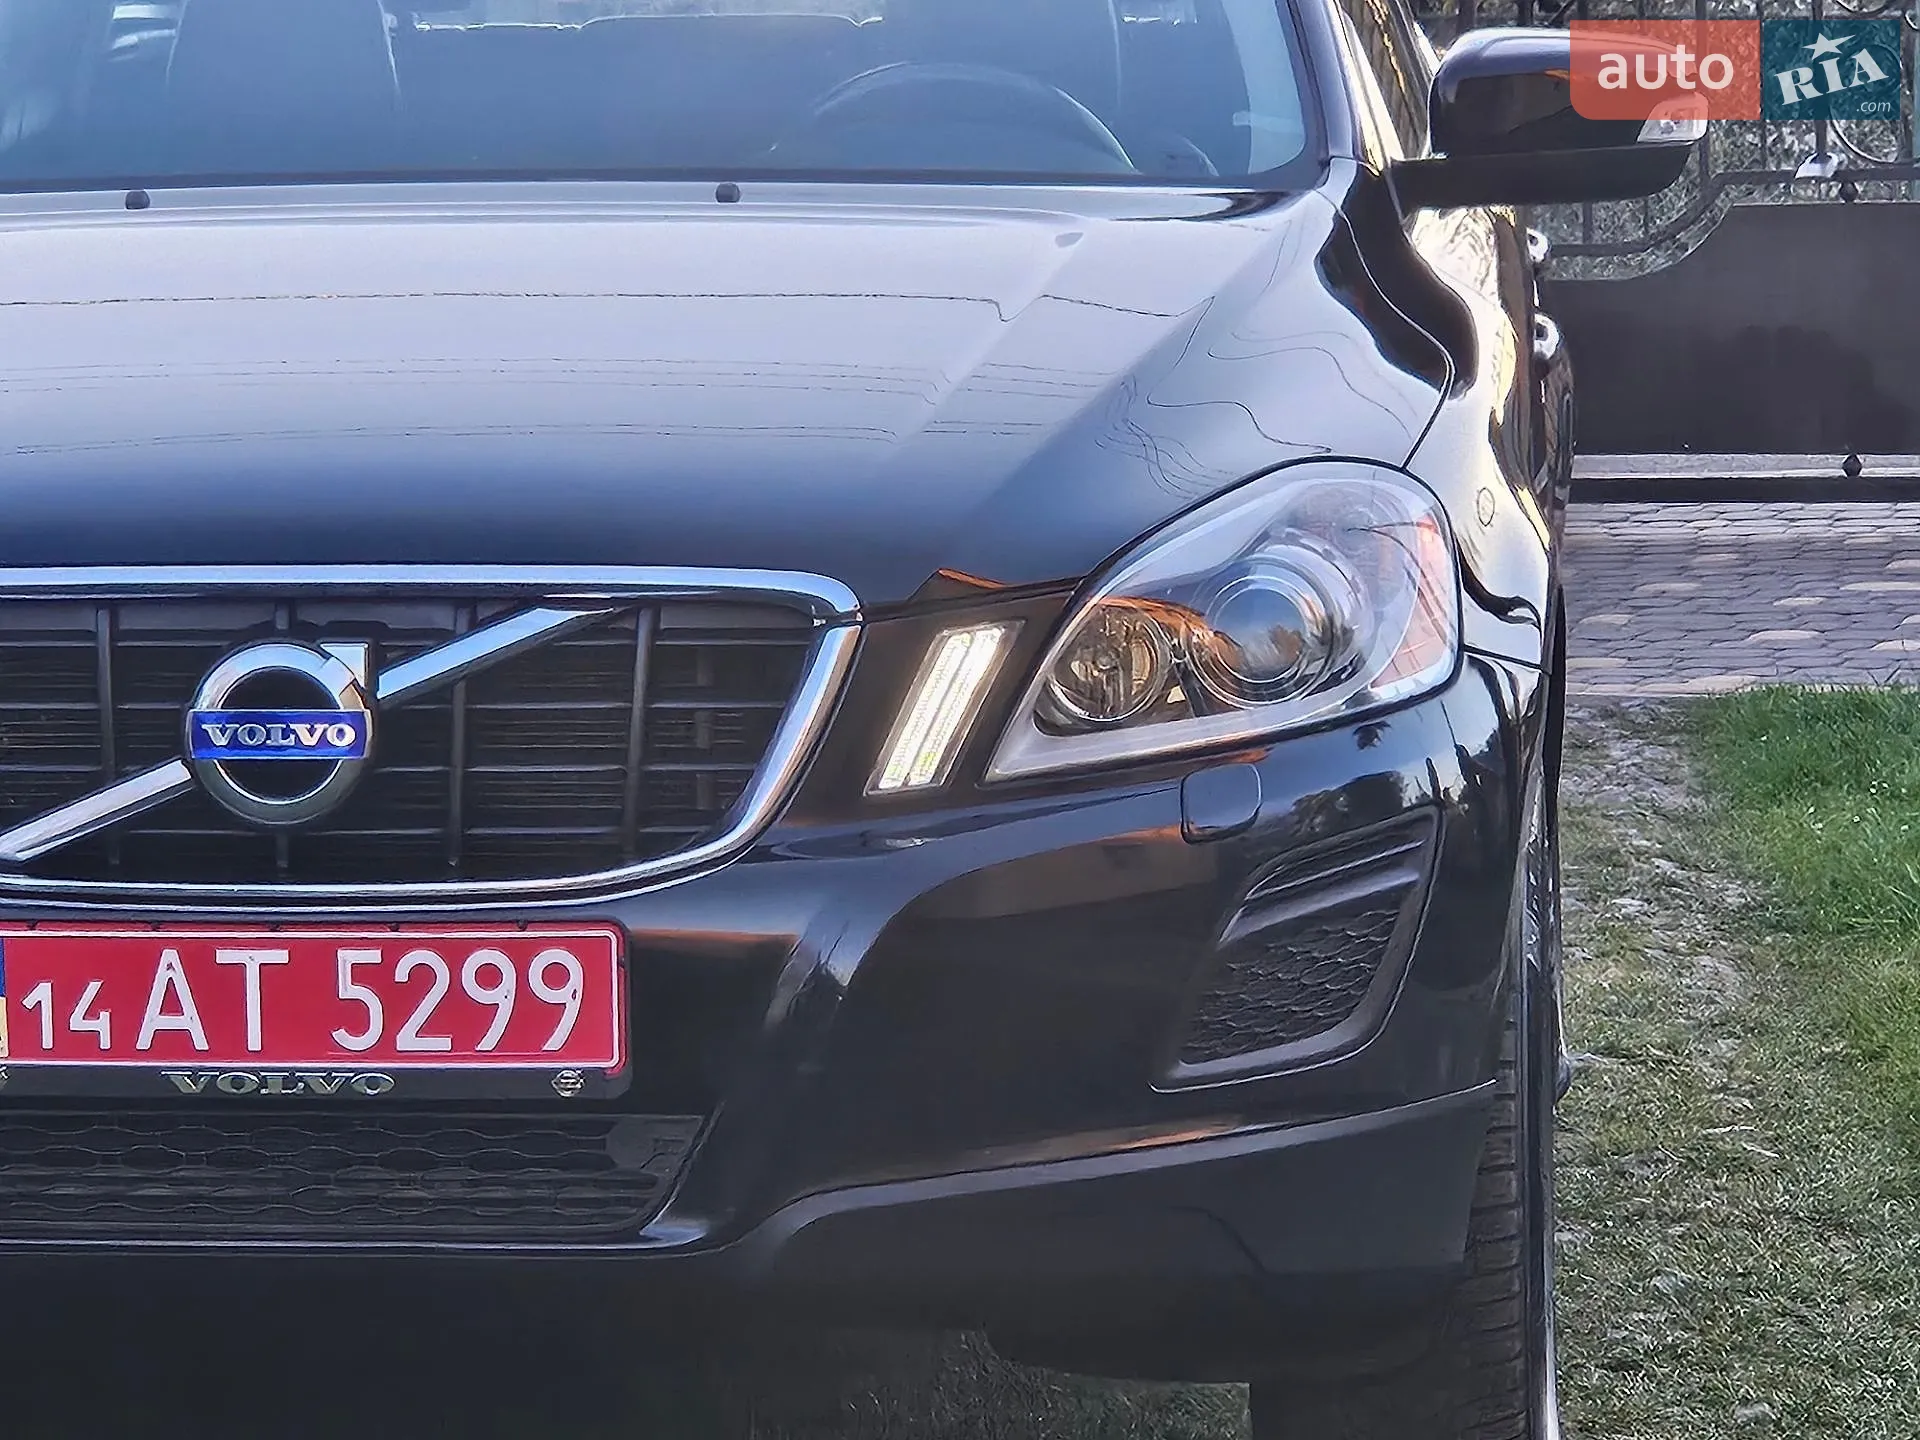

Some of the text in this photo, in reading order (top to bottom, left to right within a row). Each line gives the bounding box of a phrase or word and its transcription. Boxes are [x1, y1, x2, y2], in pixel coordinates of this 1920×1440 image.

[202, 723, 355, 747] VOLVO
[21, 948, 585, 1053] 14 AT 5299
[161, 1071, 396, 1096] VOLVO
